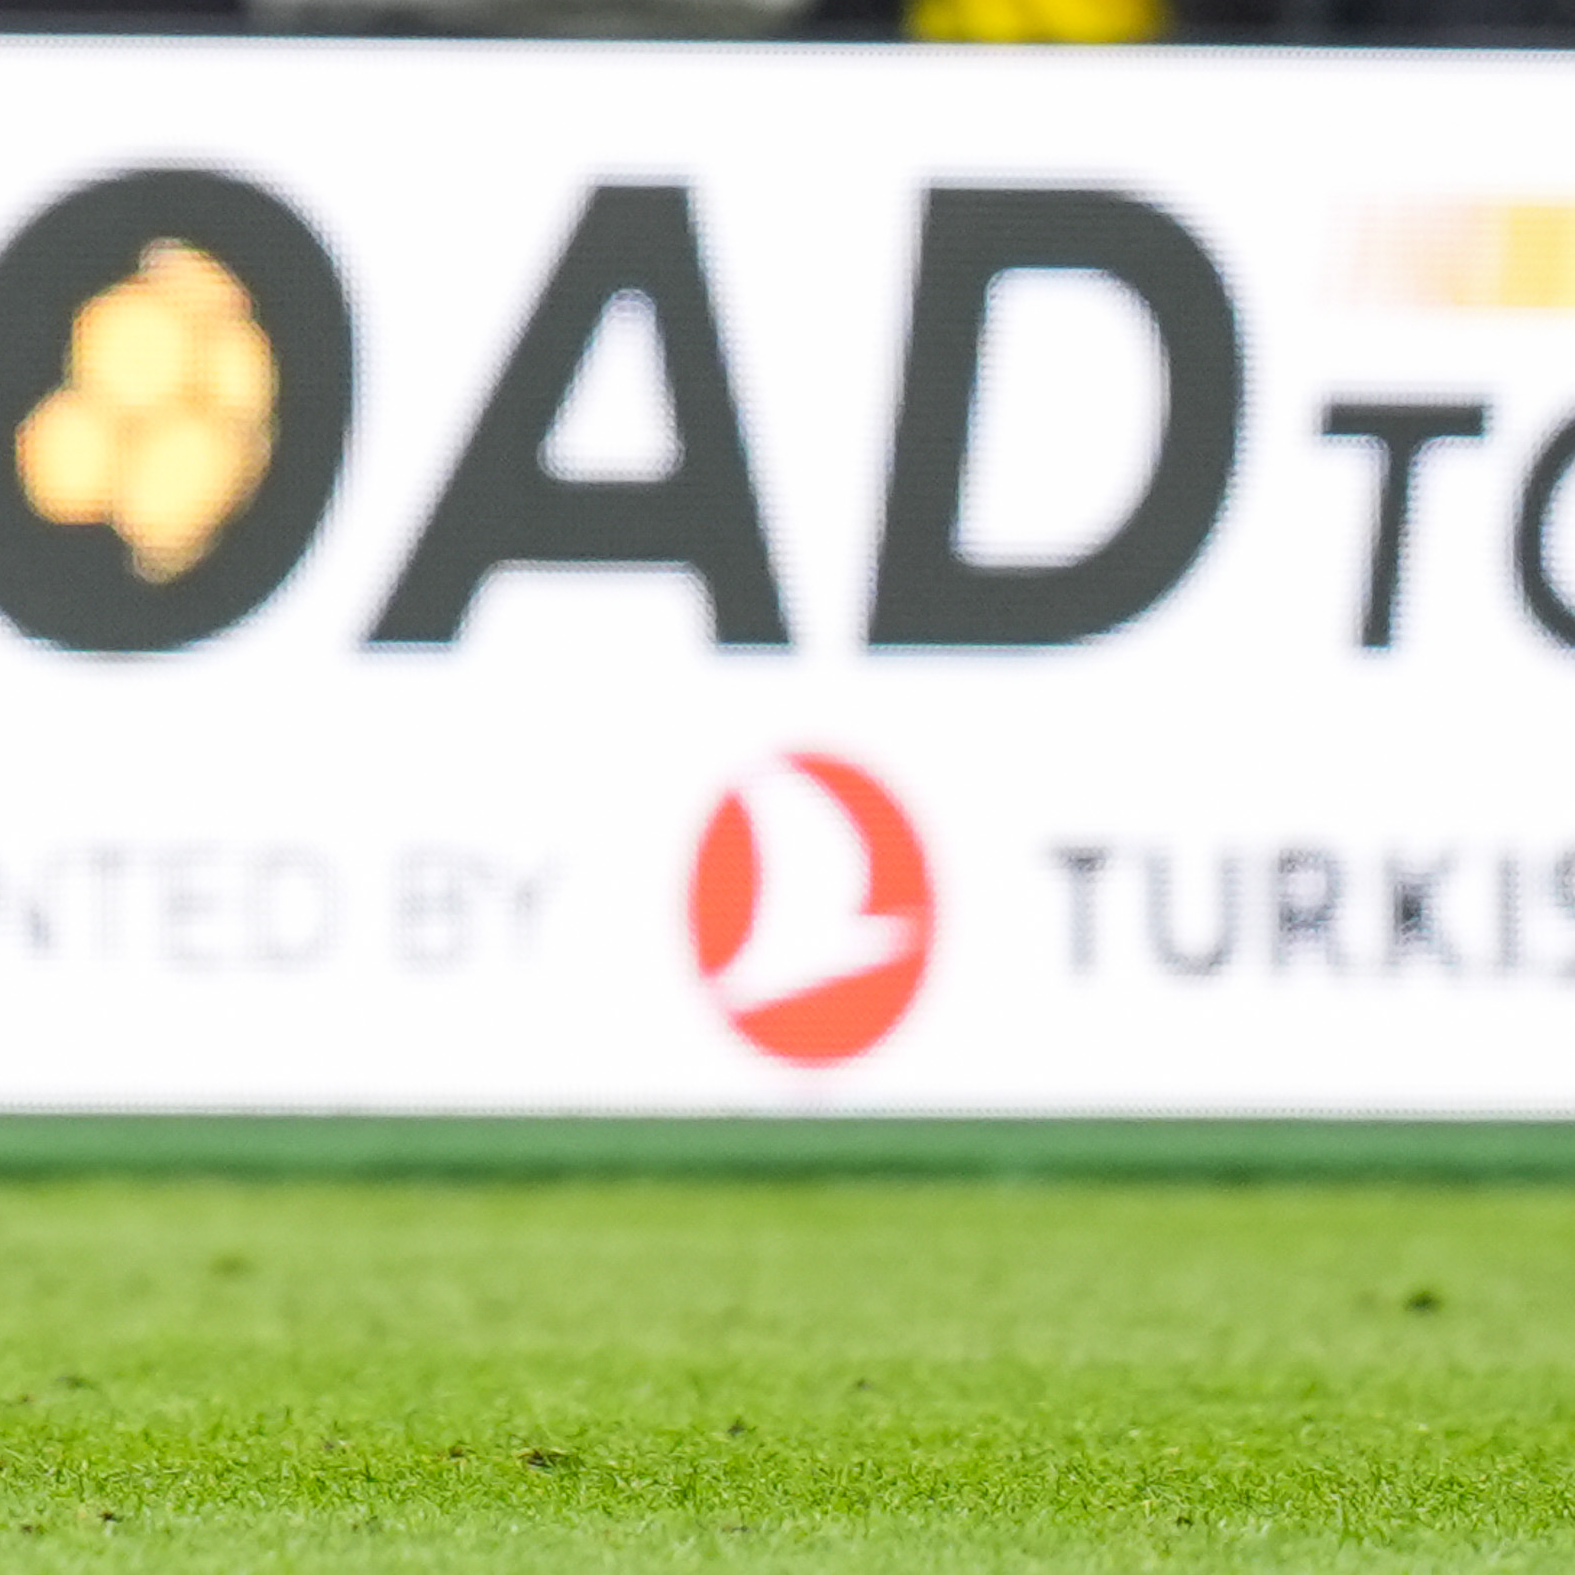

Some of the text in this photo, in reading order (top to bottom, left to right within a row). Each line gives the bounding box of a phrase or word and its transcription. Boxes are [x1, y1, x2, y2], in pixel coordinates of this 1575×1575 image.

[1322, 396, 1575, 648] T
[391, 840, 565, 974] BY
[1046, 838, 1575, 986] TURKI
